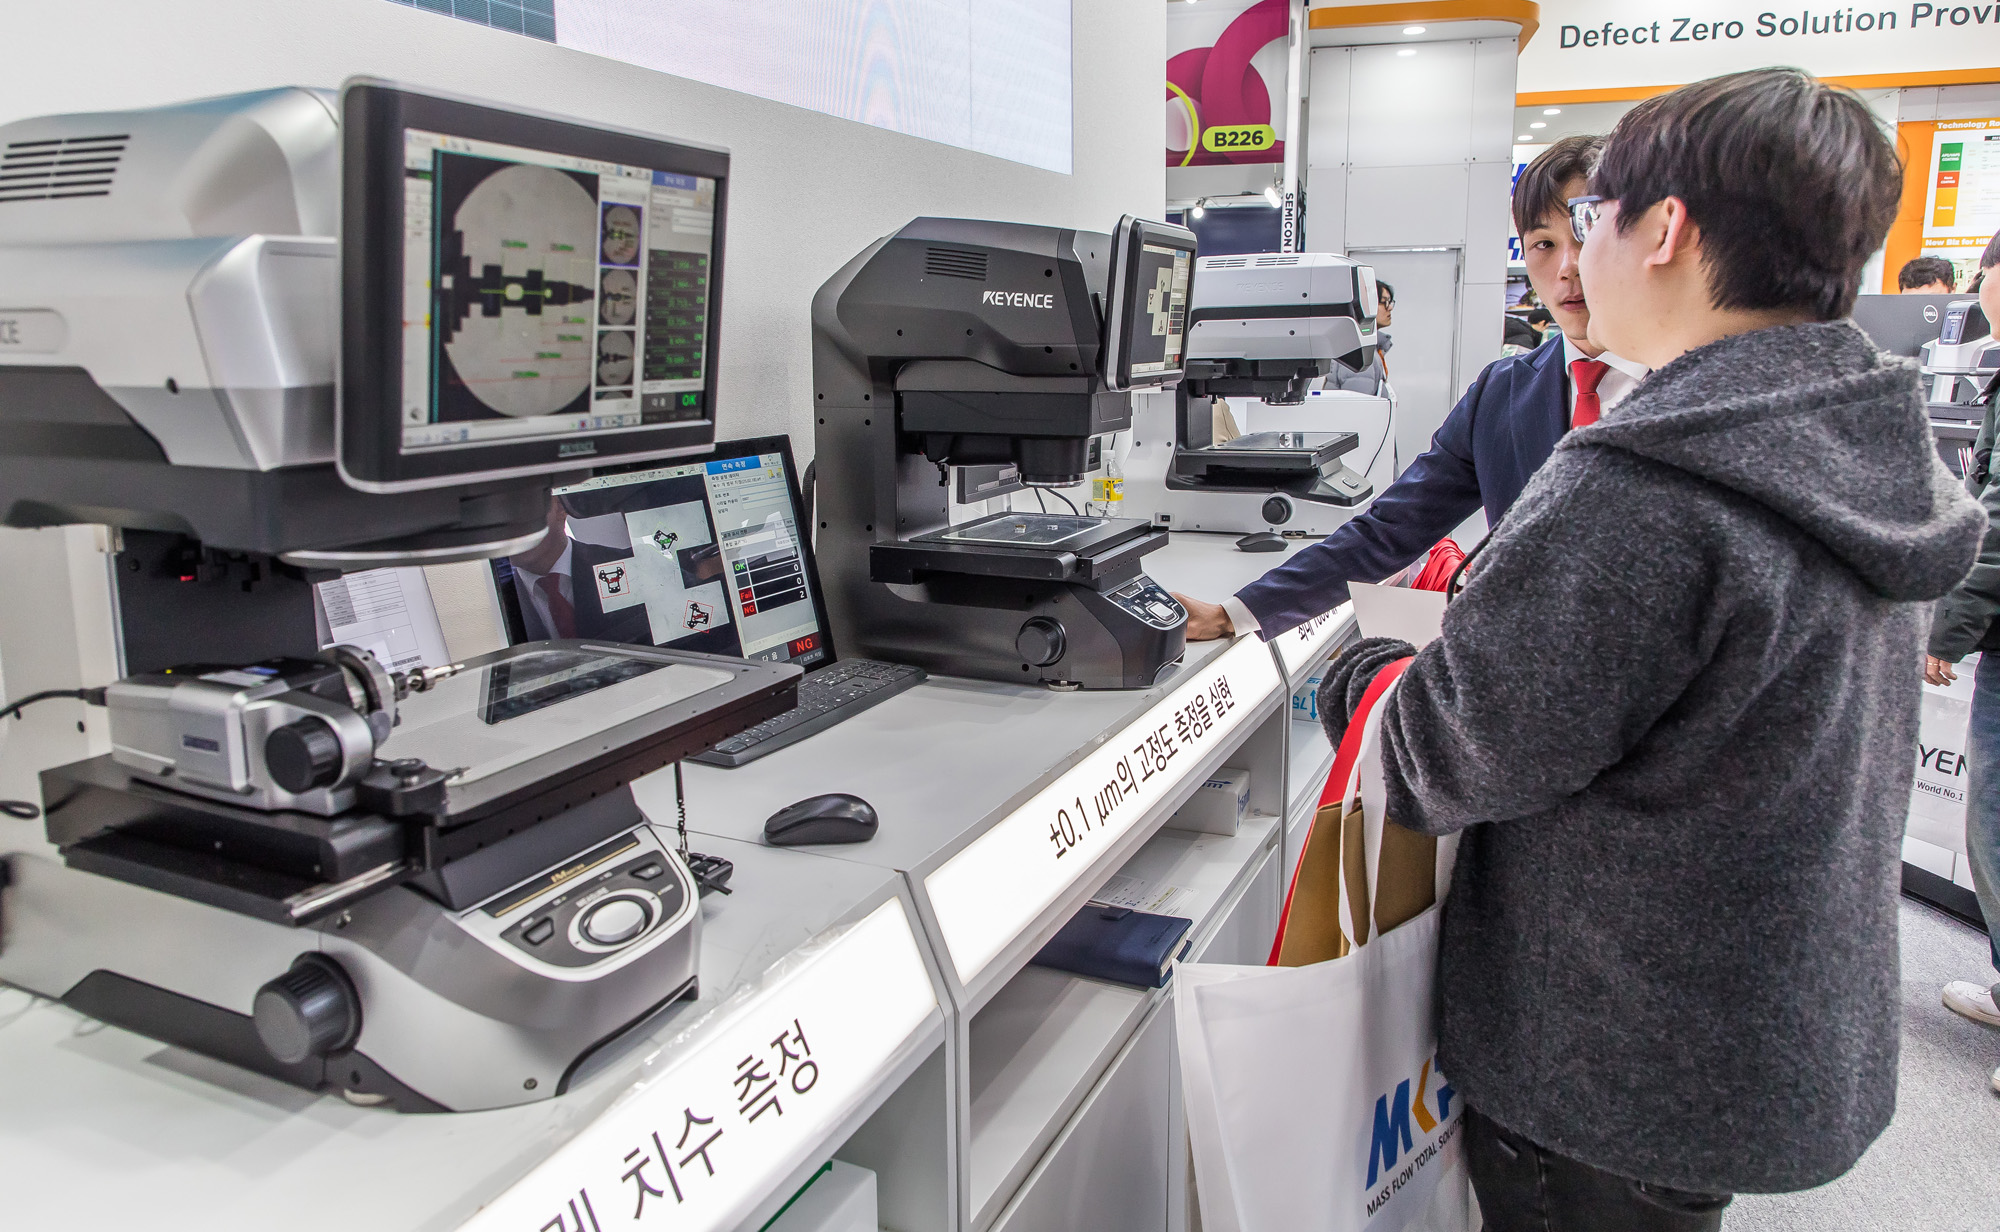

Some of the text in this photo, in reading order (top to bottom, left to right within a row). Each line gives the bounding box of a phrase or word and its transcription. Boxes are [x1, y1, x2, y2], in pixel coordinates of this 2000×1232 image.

[1559, 21, 1660, 49] Defect
[1669, 18, 1744, 42] Zero
[1756, 8, 1897, 38] Solution
[1937, 121, 1987, 129] Technology
[1214, 130, 1264, 147] B226
[1283, 192, 1294, 247] SEMICON
[982, 290, 1054, 309] KEYENCE
[682, 393, 696, 407] OK
[721, 460, 746, 471] 연속 측정
[735, 562, 746, 571] OK
[793, 563, 799, 571] 0
[740, 591, 752, 600] Fail
[743, 591, 805, 614] NG 2
[796, 638, 813, 653] NG
[1050, 797, 1091, 859] ±0.1
[1133, 724, 1179, 783] 고정도
[1174, 694, 1213, 745] 측정을
[1209, 674, 1235, 719] 실현
[1917, 780, 1963, 801] World No.1
[621, 1018, 819, 1220] 치수 측정
[1366, 1185, 1391, 1218] MASS
[1392, 1163, 1414, 1195] FLOW
[1414, 1142, 1438, 1172] TOTAL
